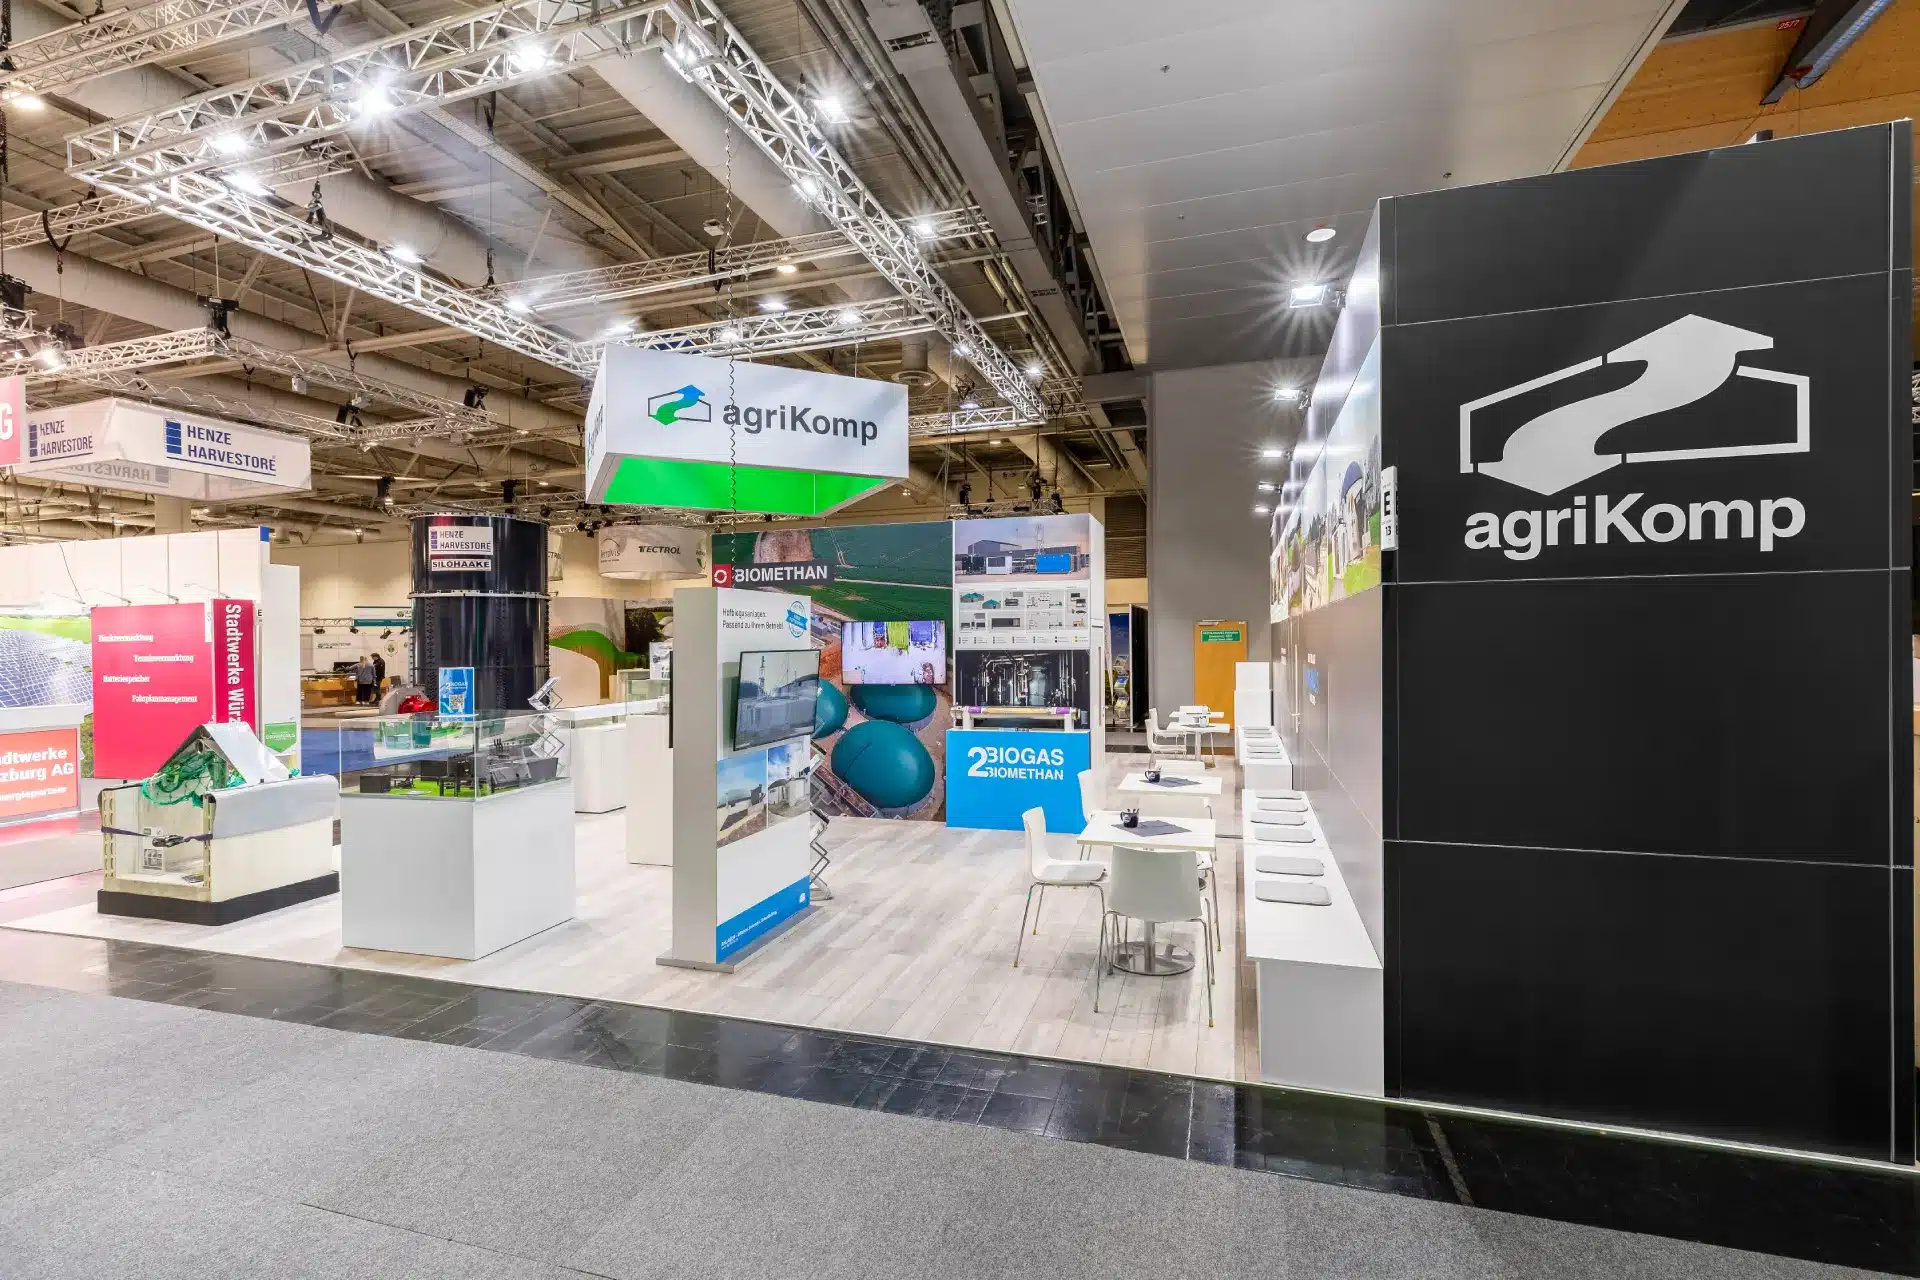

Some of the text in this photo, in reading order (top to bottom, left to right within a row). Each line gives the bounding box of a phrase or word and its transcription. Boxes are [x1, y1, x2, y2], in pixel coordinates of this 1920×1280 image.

[1778, 19, 1800, 30] 2577
[40, 420, 65, 437] HENZE
[723, 403, 878, 446] agriKomp
[187, 425, 232, 446] HENZE
[40, 435, 93, 456] HARVESTORE
[187, 444, 277, 472] HARVESTORE
[1384, 491, 1391, 516] E
[440, 530, 464, 539] HENZE
[1464, 492, 1806, 561] agriKomp
[440, 541, 491, 550] HARVESTORE
[638, 545, 682, 555] TECTROL
[734, 565, 828, 582] BIOMETHAN
[225, 604, 245, 685] Stadtwerke
[51, 762, 74, 777] AG
[985, 766, 1064, 781] BIOMETHAN
